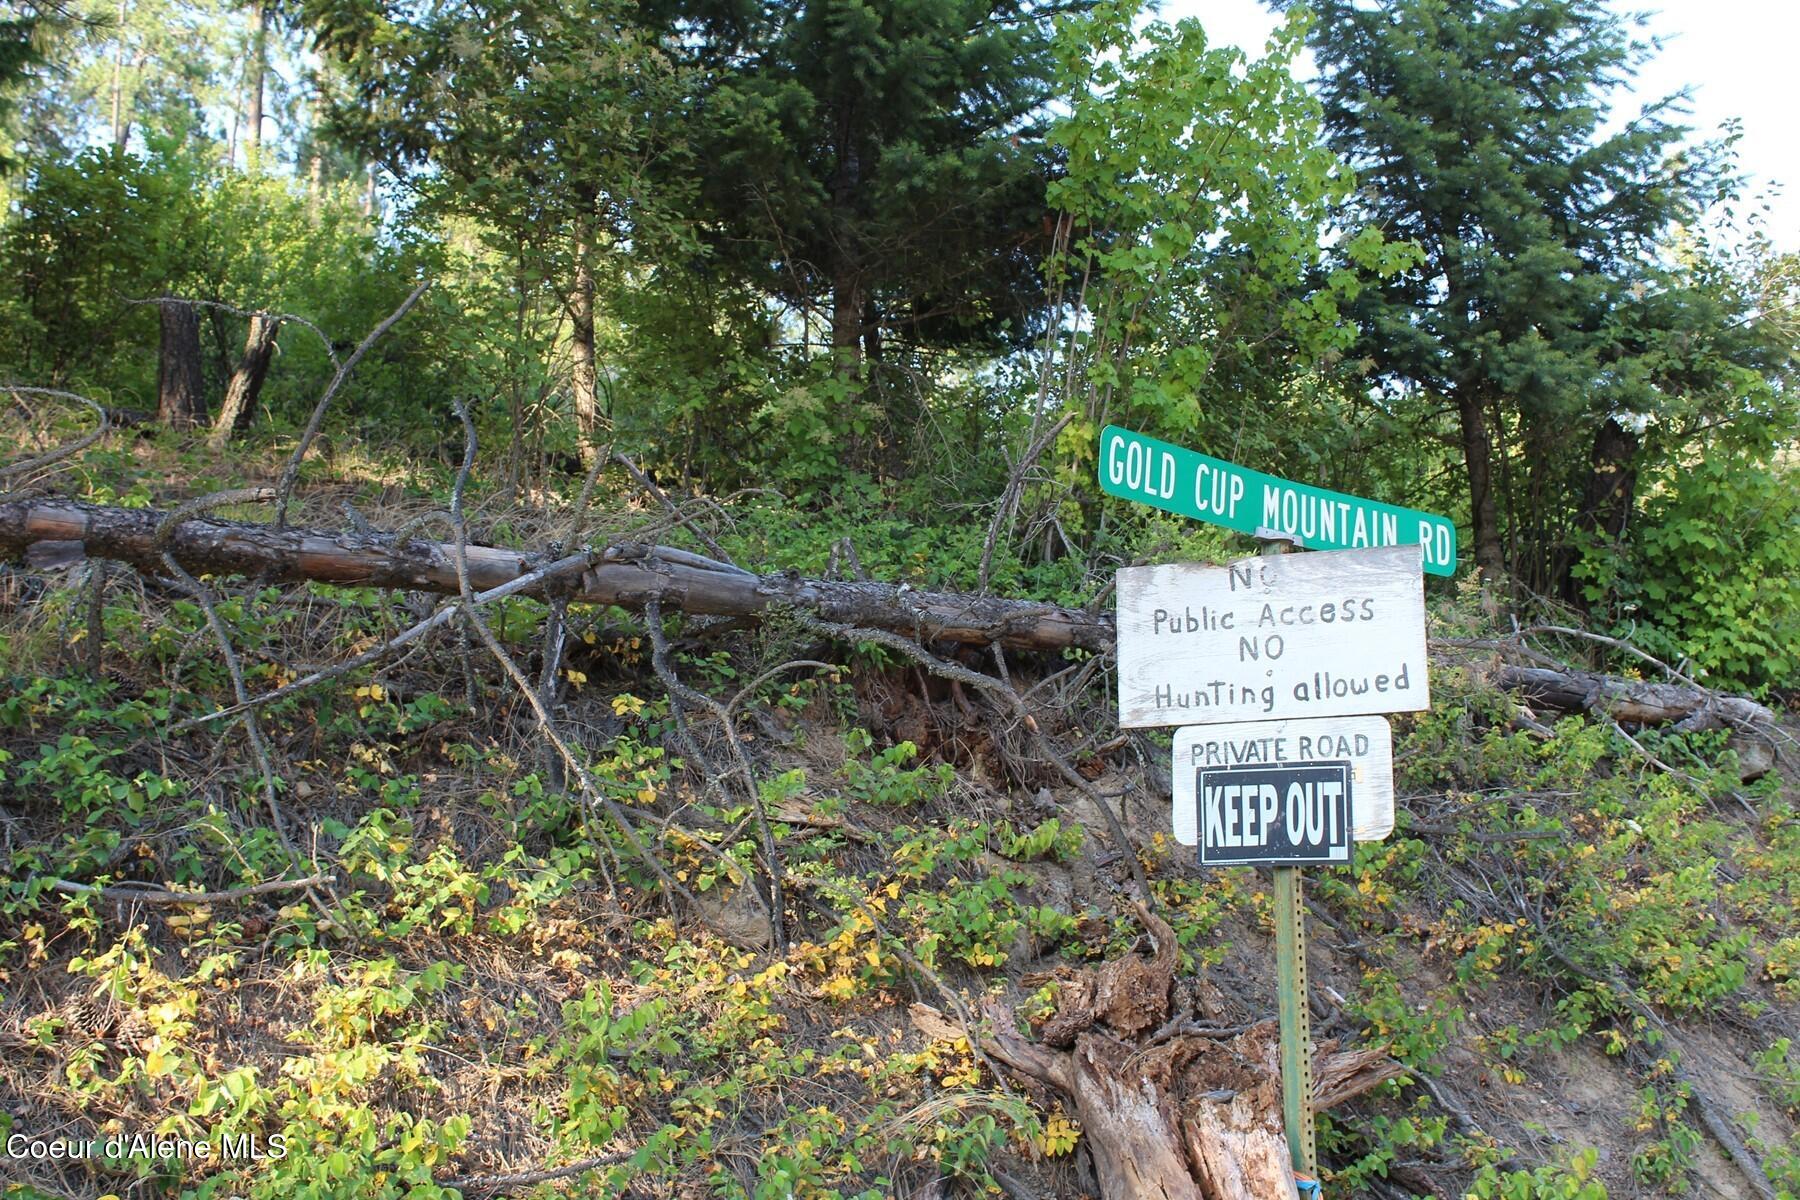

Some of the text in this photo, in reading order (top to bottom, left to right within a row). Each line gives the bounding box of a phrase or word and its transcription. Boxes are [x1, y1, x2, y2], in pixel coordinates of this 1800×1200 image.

[1108, 435, 1451, 566] GOLD CUP MOUNTAIN RD
[1154, 598, 1375, 634] Public Access
[1239, 634, 1284, 662] NO
[1293, 662, 1411, 702] allowed
[1191, 733, 1369, 766] PRIVATE ROAD
[1205, 781, 1342, 848] KEEP OUT
